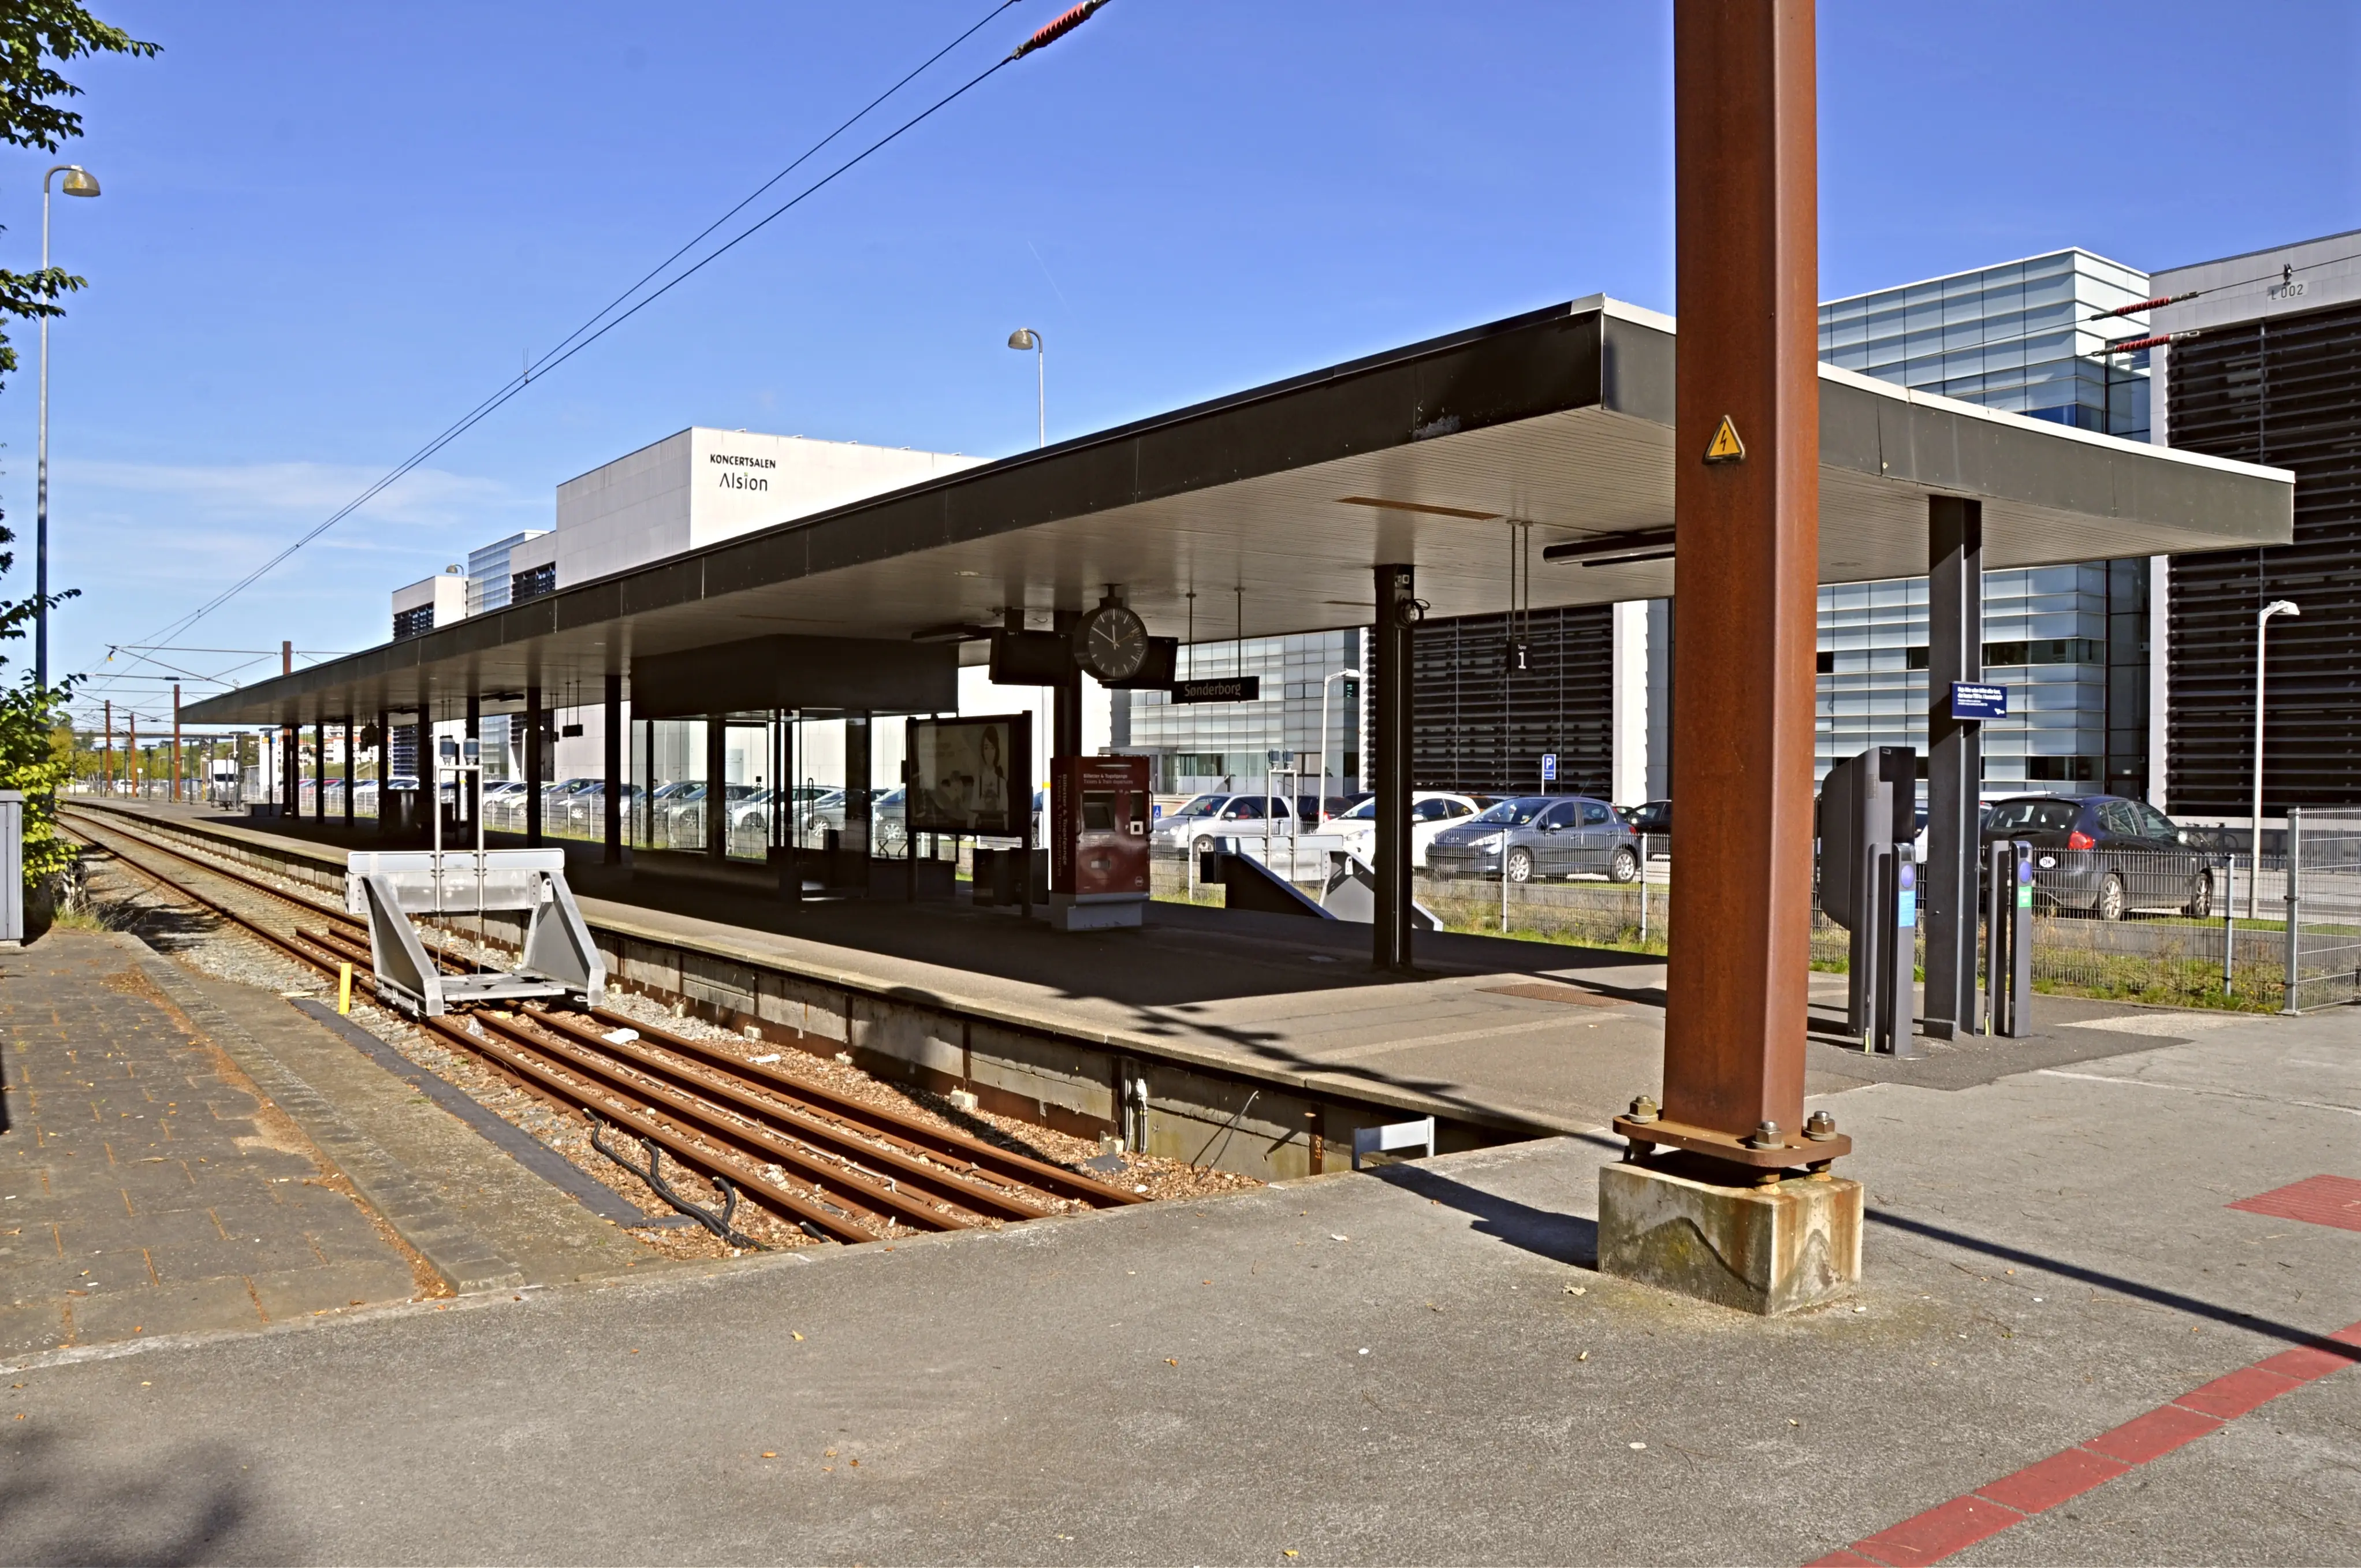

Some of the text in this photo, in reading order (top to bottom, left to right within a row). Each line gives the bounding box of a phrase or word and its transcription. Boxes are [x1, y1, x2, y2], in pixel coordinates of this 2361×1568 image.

[2271, 284, 2303, 300] L 002
[710, 454, 776, 469] KONCERTSALEN
[720, 472, 768, 491] Alsion
[1518, 651, 1526, 669] 1
[1184, 682, 1241, 697] Sønderborg
[1546, 758, 1553, 769] P
